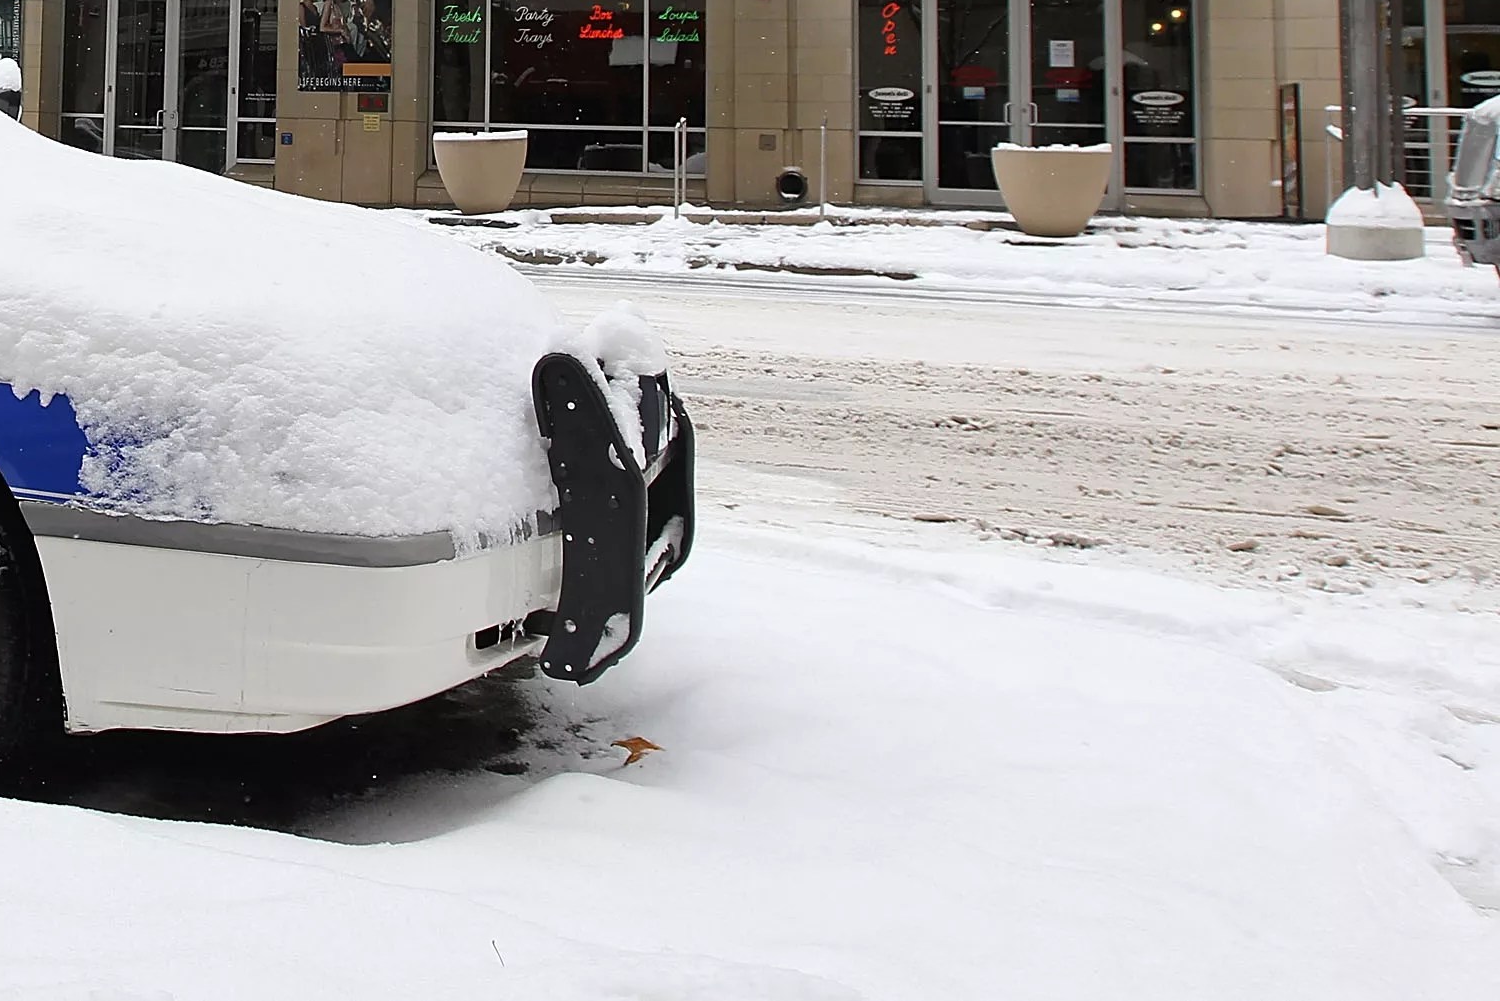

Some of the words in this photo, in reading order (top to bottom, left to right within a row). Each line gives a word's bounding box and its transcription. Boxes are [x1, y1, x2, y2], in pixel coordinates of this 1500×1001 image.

[441, 5, 481, 22] Fresh
[514, 6, 554, 27] Party
[589, 4, 614, 20] Box
[658, 6, 700, 24] Soups
[442, 25, 481, 43] Fruit
[579, 24, 624, 39] Lunches
[656, 27, 700, 42] Salads
[881, 2, 900, 55] Open
[514, 28, 553, 48] Trays
[299, 77, 314, 87] LIFE
[315, 77, 341, 87] BEGINS
